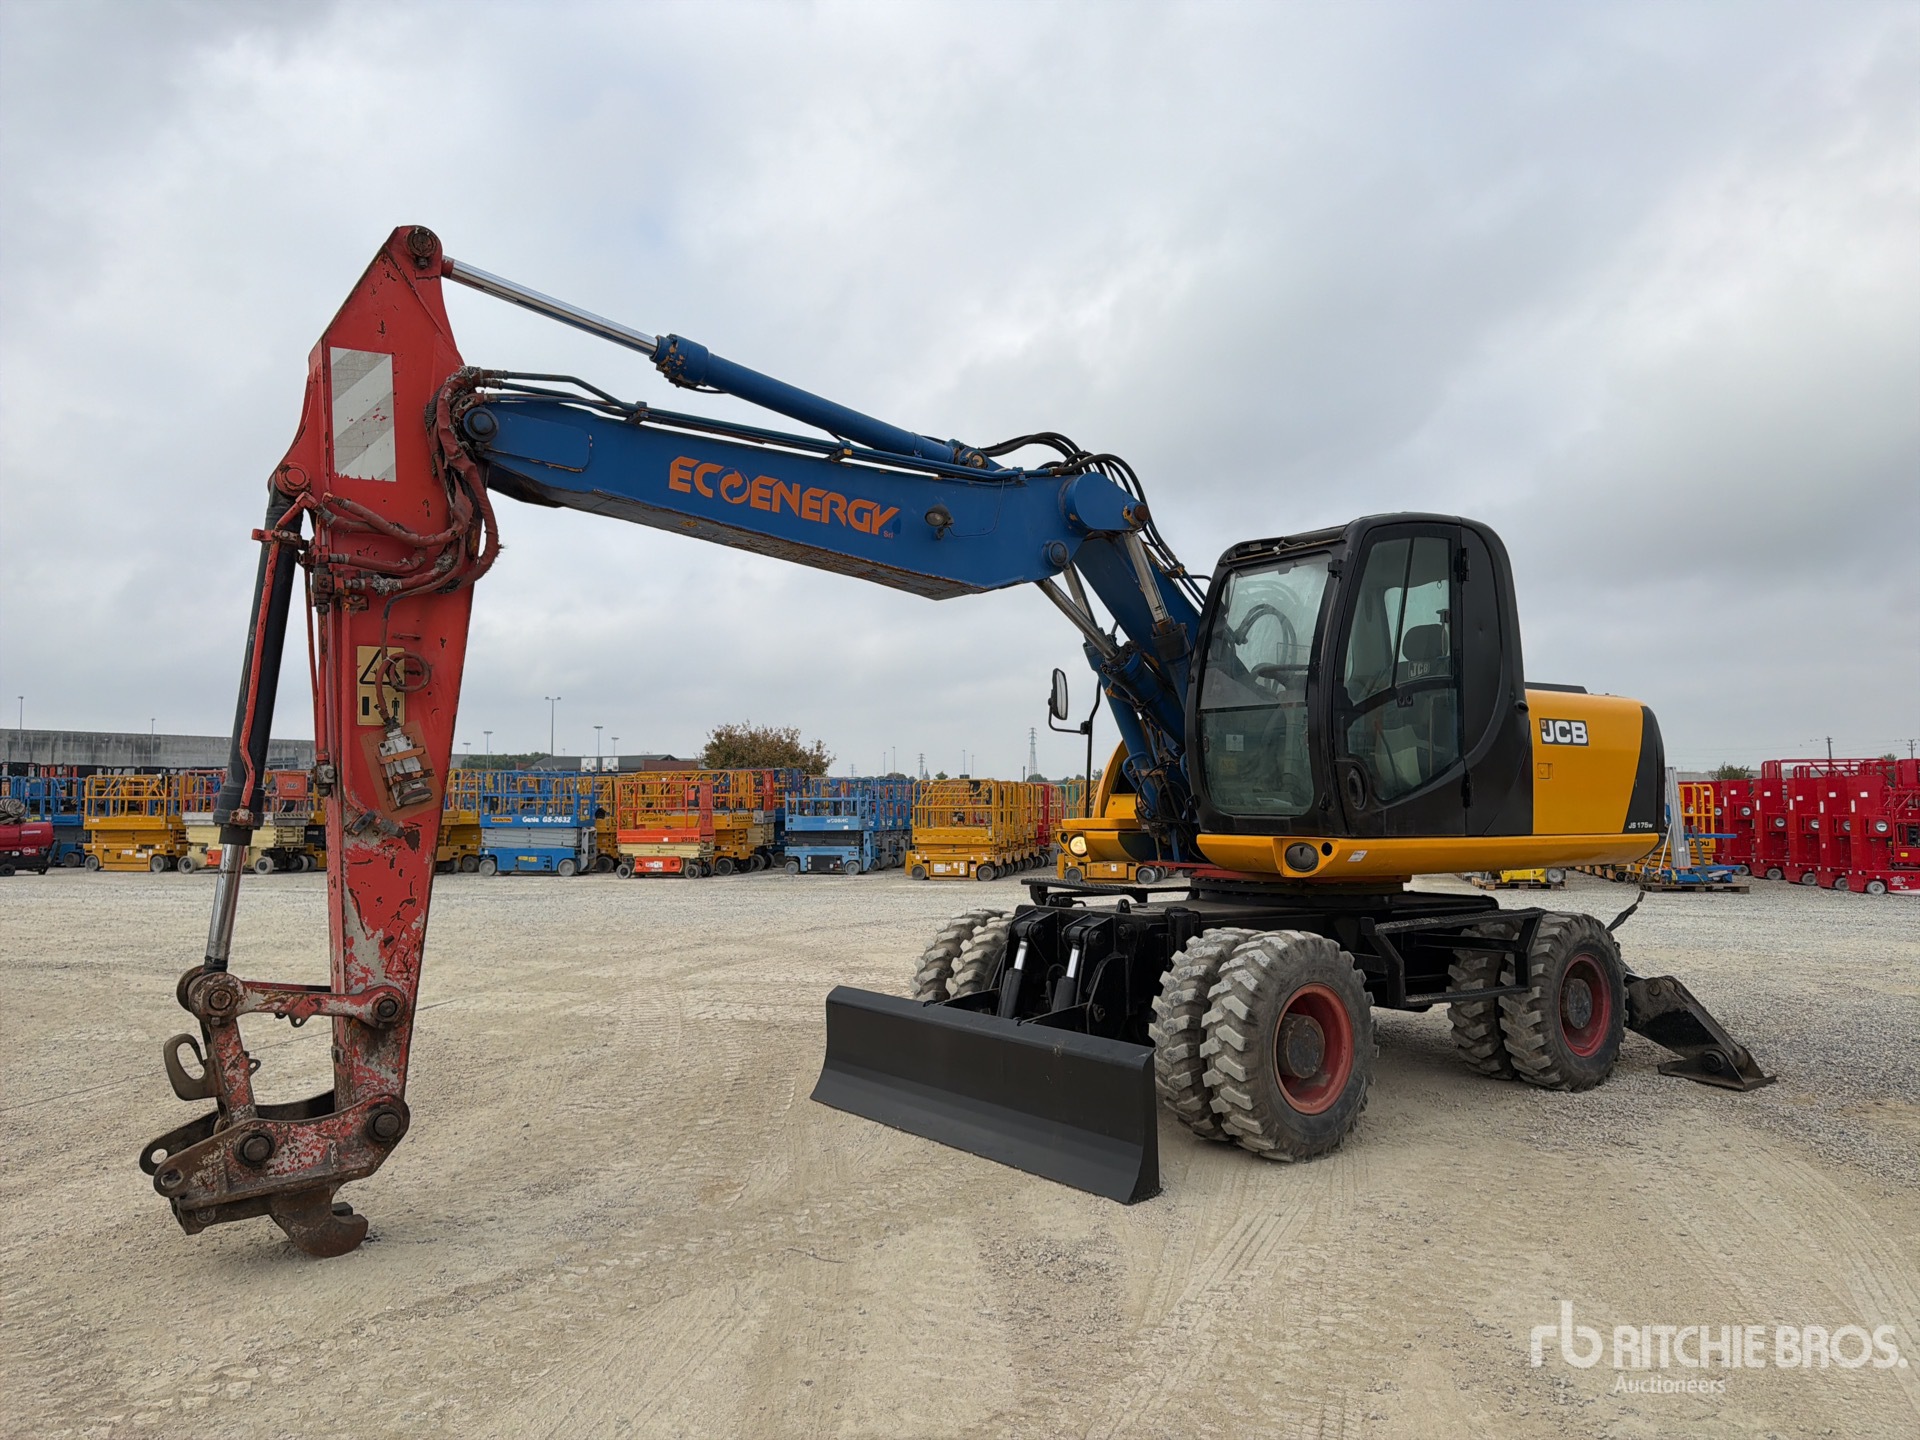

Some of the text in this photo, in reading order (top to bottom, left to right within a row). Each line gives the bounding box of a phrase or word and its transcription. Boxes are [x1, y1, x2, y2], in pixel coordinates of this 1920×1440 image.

[669, 456, 900, 534] ECOENERGY
[883, 530, 894, 539] Srl
[1410, 662, 1428, 677] JCB
[1541, 719, 1588, 744] JCB
